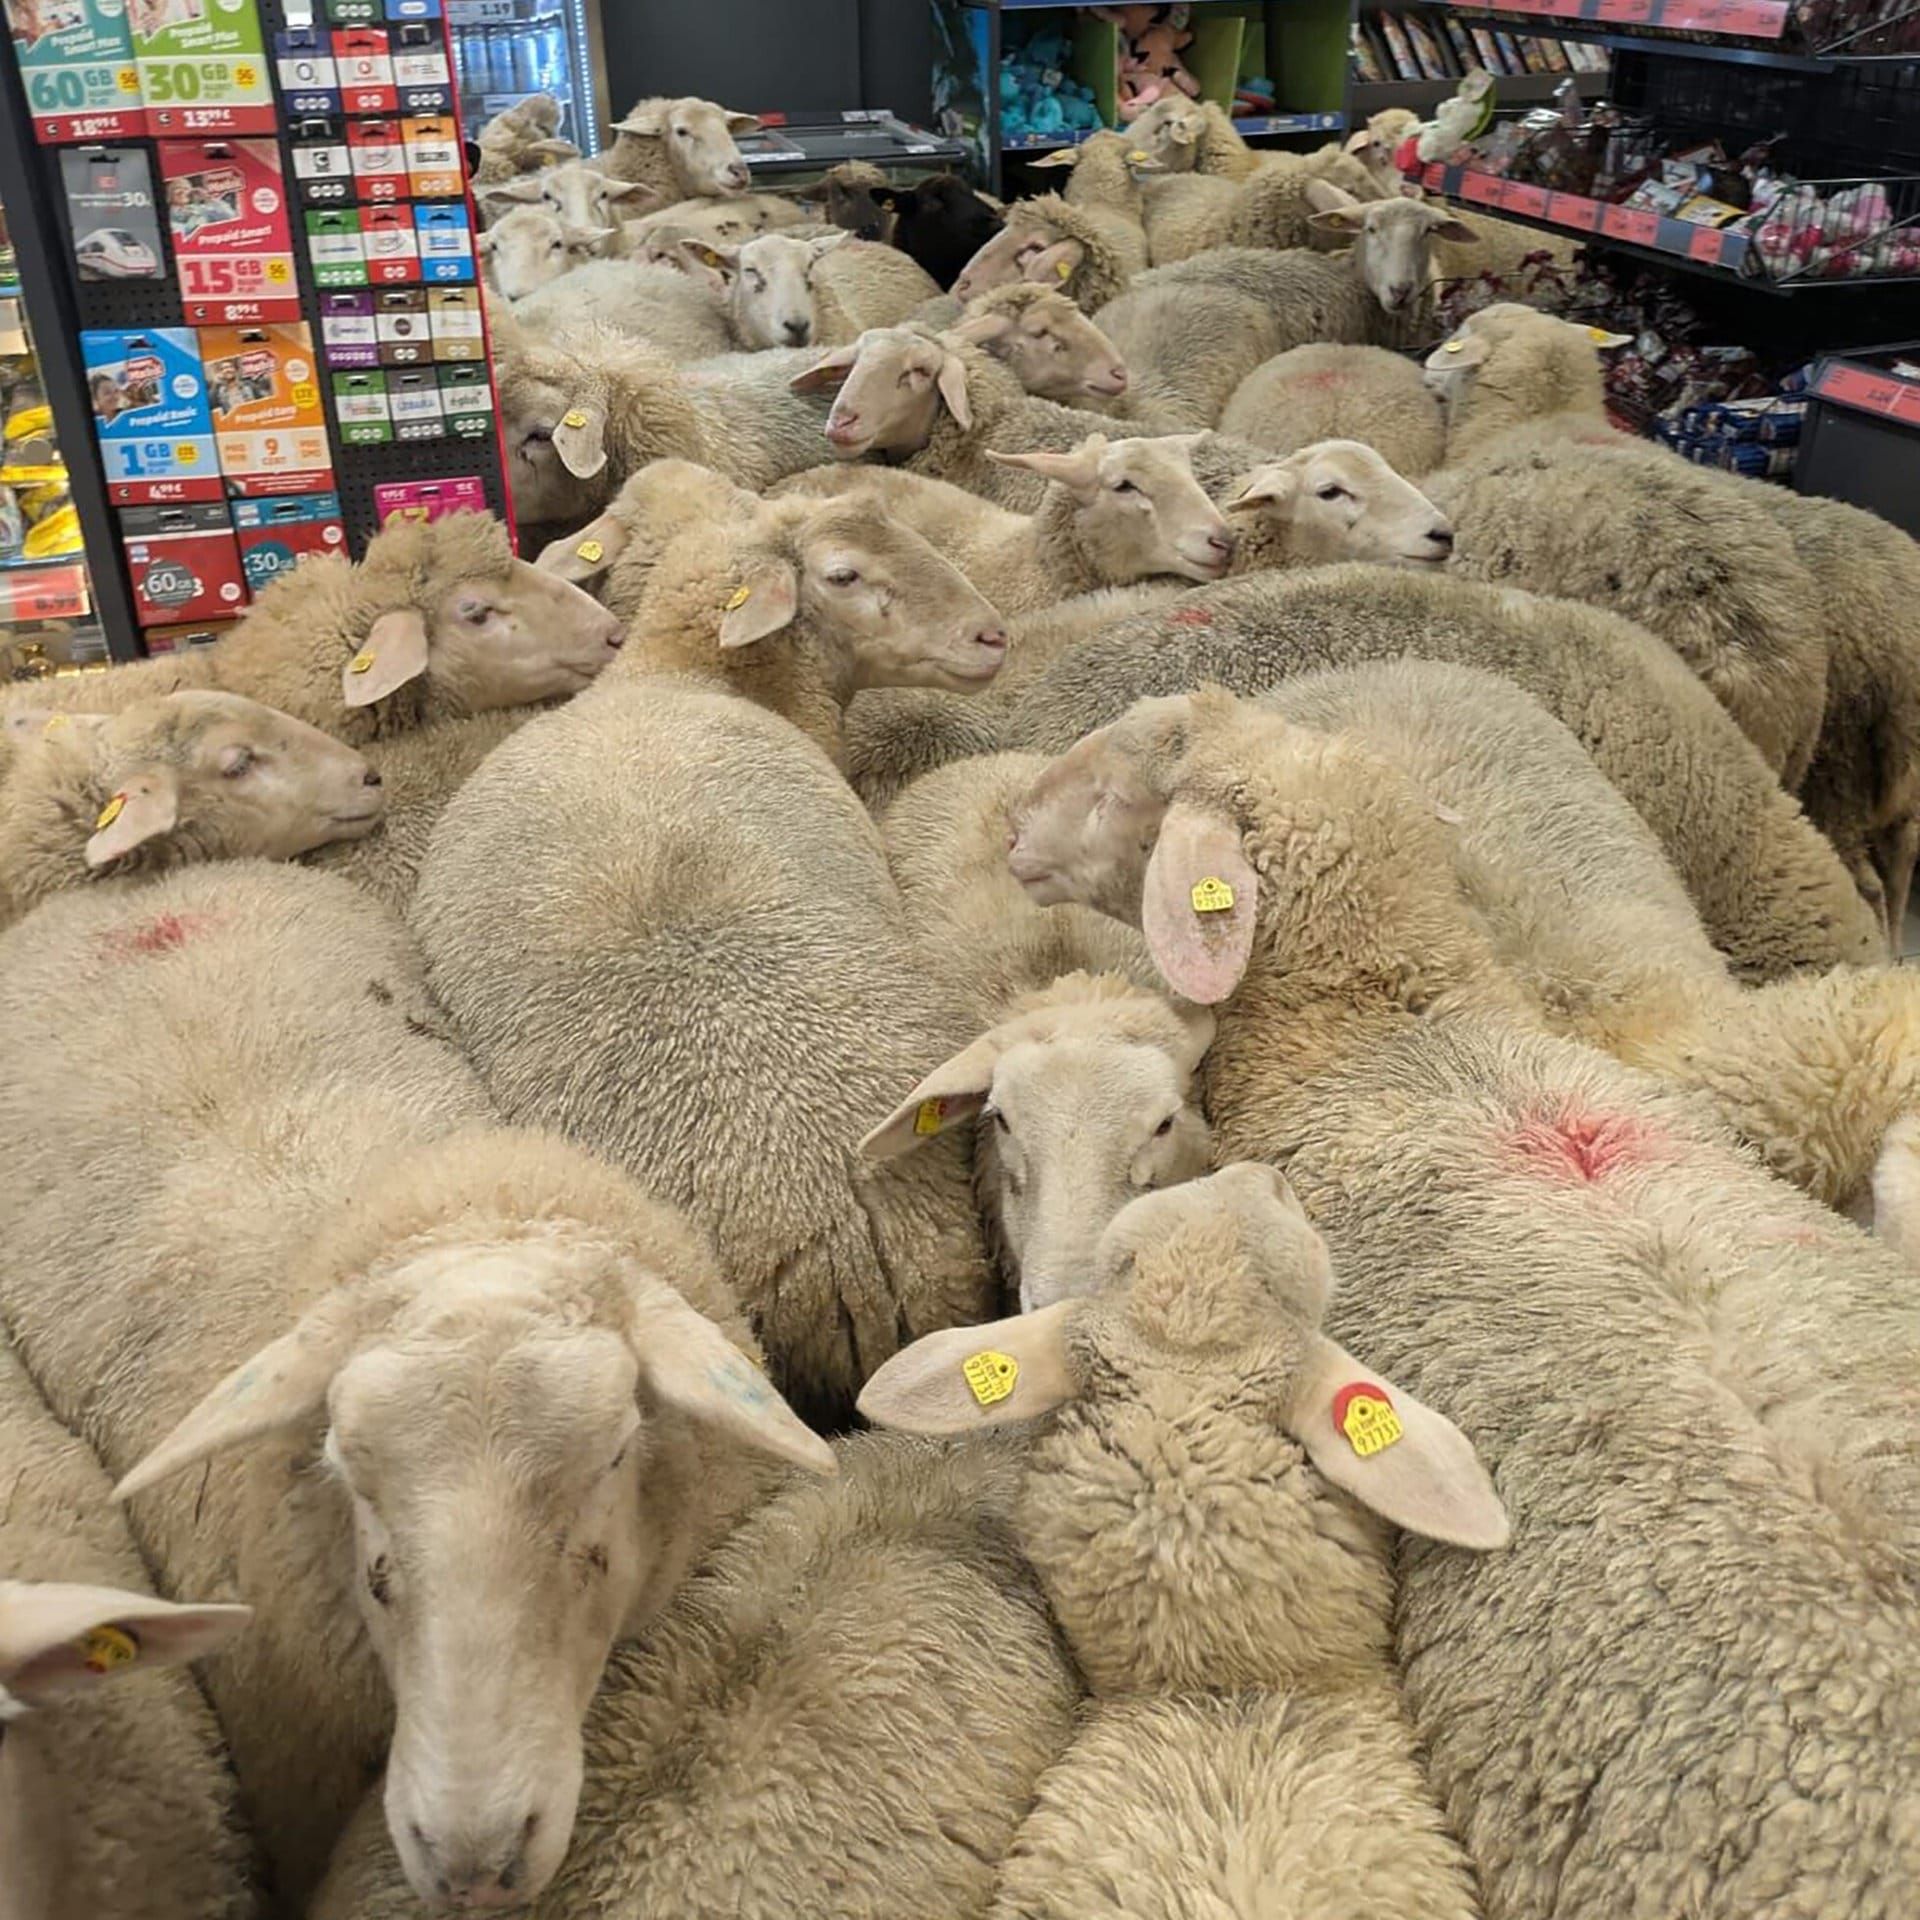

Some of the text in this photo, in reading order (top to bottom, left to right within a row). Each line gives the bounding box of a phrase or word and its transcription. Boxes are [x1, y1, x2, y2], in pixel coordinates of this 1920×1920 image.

[31, 70, 85, 110] 60
[84, 69, 113, 87] GB
[145, 63, 200, 101] 30
[201, 63, 229, 81] GB
[184, 260, 235, 295] 15
[235, 260, 261, 276] GB
[120, 444, 146, 476] 1
[145, 443, 170, 458] GB
[265, 438, 278, 455] 9
[251, 552, 278, 571] 30
[148, 572, 176, 593] 60
[966, 1361, 995, 1400] 97731
